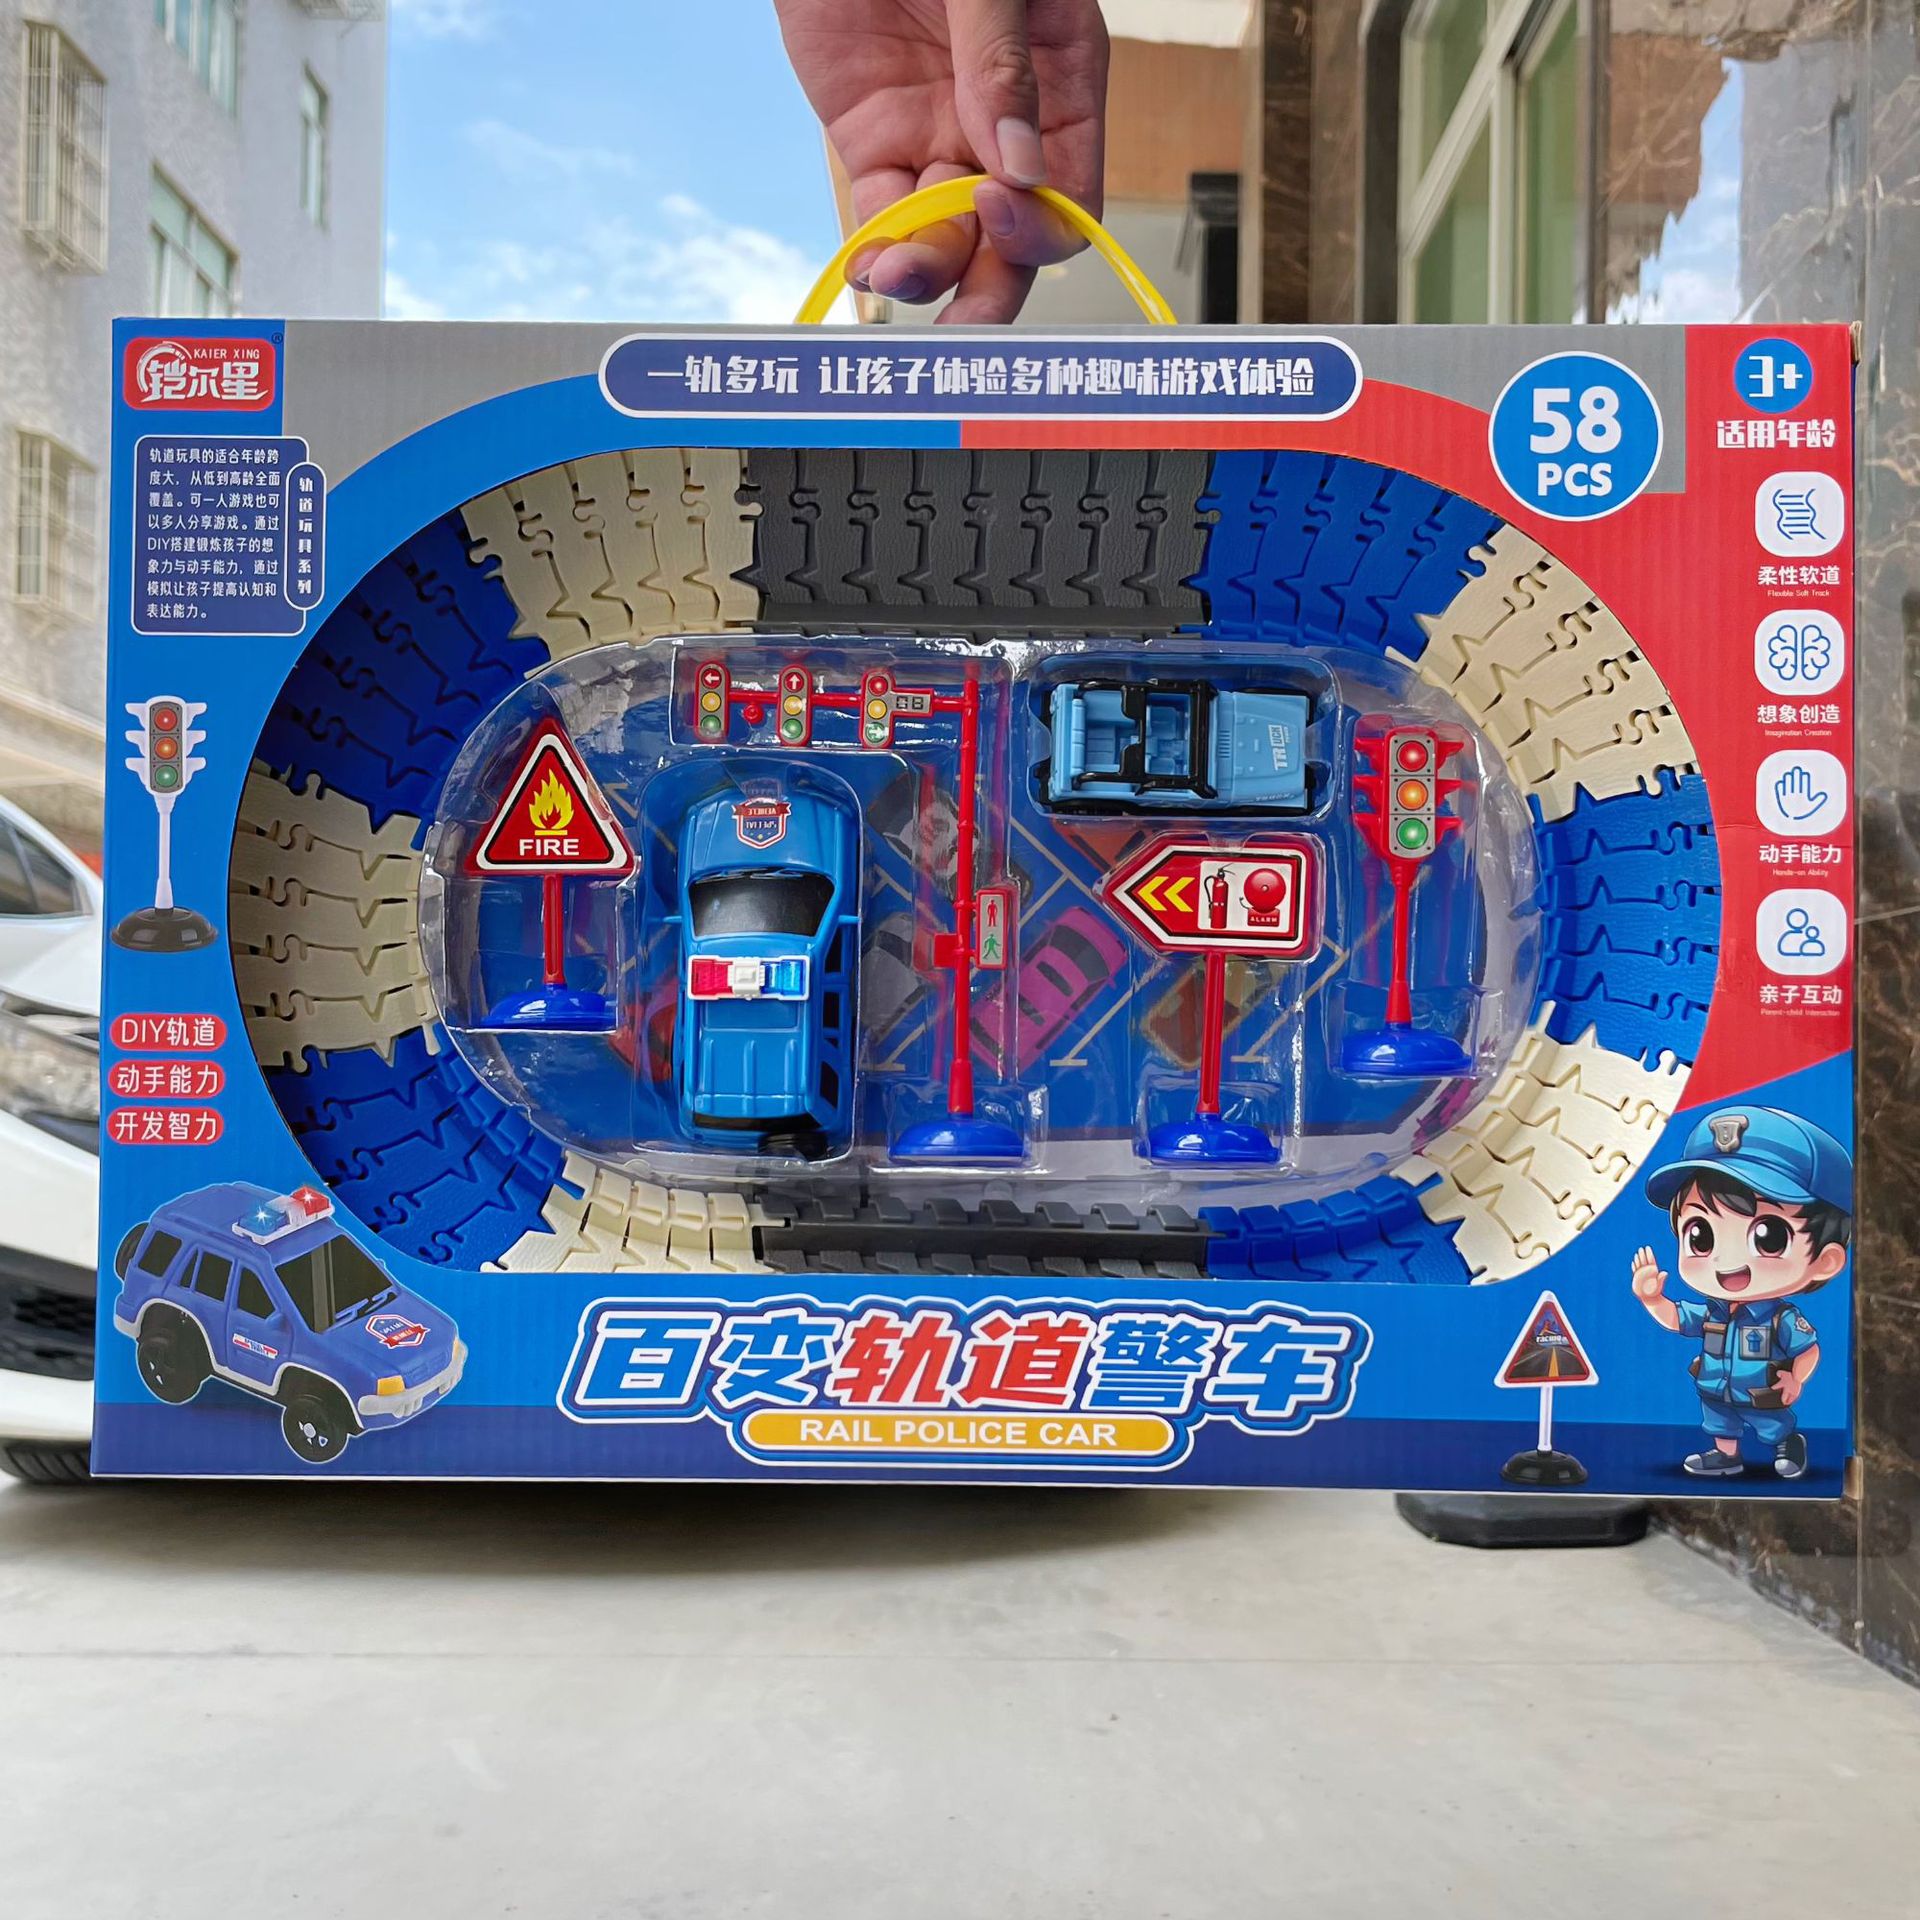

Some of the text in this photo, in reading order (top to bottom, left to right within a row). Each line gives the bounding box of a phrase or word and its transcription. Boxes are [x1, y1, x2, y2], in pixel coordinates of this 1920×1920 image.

[194, 349, 260, 360] KAIER XING
[646, 355, 1315, 396] 一轨多玩 让孩子体验多种趣味游戏体验
[1748, 355, 1803, 398] 3+
[1529, 385, 1622, 454] 58
[1717, 419, 1836, 448] 适用年龄
[150, 448, 279, 464] 轨道玩具的适合年龄跨
[1537, 462, 1612, 497] PCS
[297, 477, 313, 594] 轨道玩具系列
[1758, 565, 1840, 585] 柔性软道
[147, 582, 277, 597] 模拟让孩子提高认知和
[1796, 589, 1809, 597] Soft
[1757, 704, 1840, 724] 想象创造
[519, 838, 580, 856] FIRE
[1759, 844, 1842, 864] 动手能力
[1760, 984, 1842, 1004] 亲子互动
[121, 1017, 216, 1046] DIY轨道
[117, 1064, 218, 1094] 动手能力
[115, 1111, 217, 1141] 开发智力
[583, 1312, 1343, 1412] 百变轨道警车
[799, 1419, 1117, 1447] RAIL POLICE CAR
